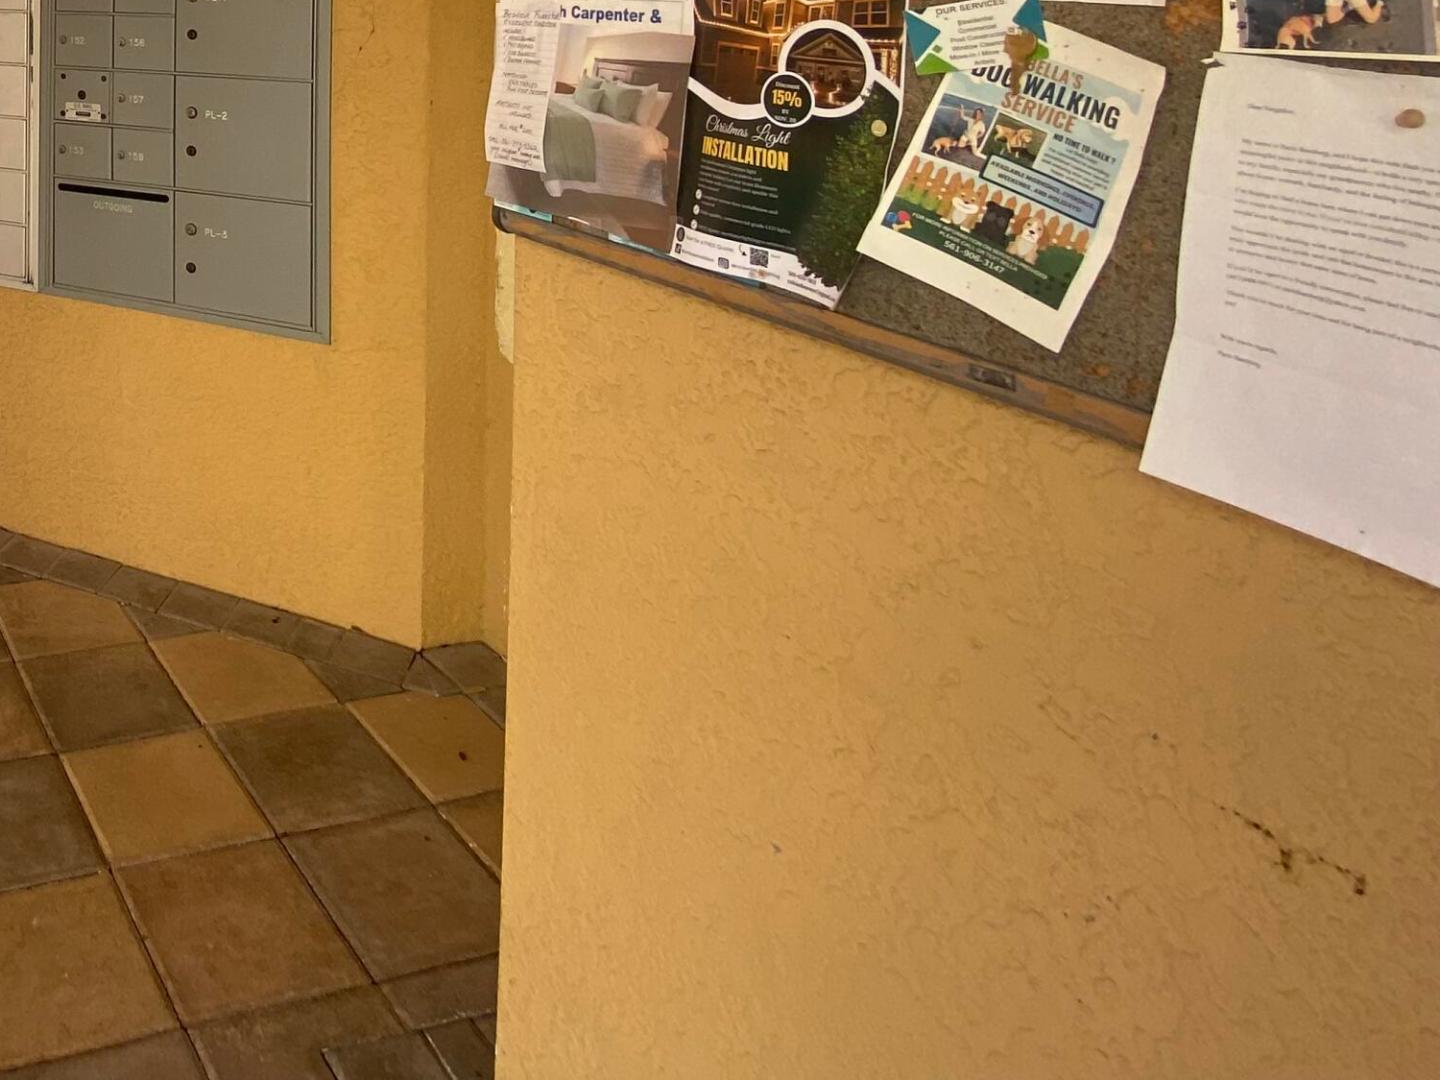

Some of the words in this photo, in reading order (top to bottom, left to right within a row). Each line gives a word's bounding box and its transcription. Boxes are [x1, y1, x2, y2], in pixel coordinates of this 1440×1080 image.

[571, 6, 645, 23] Carpenter
[650, 8, 662, 24] &
[935, 5, 957, 15] OUR
[772, 89, 802, 108] 15%
[1023, 74, 1120, 130] WALKING
[204, 110, 228, 121] PL-2
[1001, 91, 1078, 133] SERVICE
[705, 114, 749, 138] Christmas
[751, 123, 792, 148] Light
[702, 136, 789, 172] INSTALLATION
